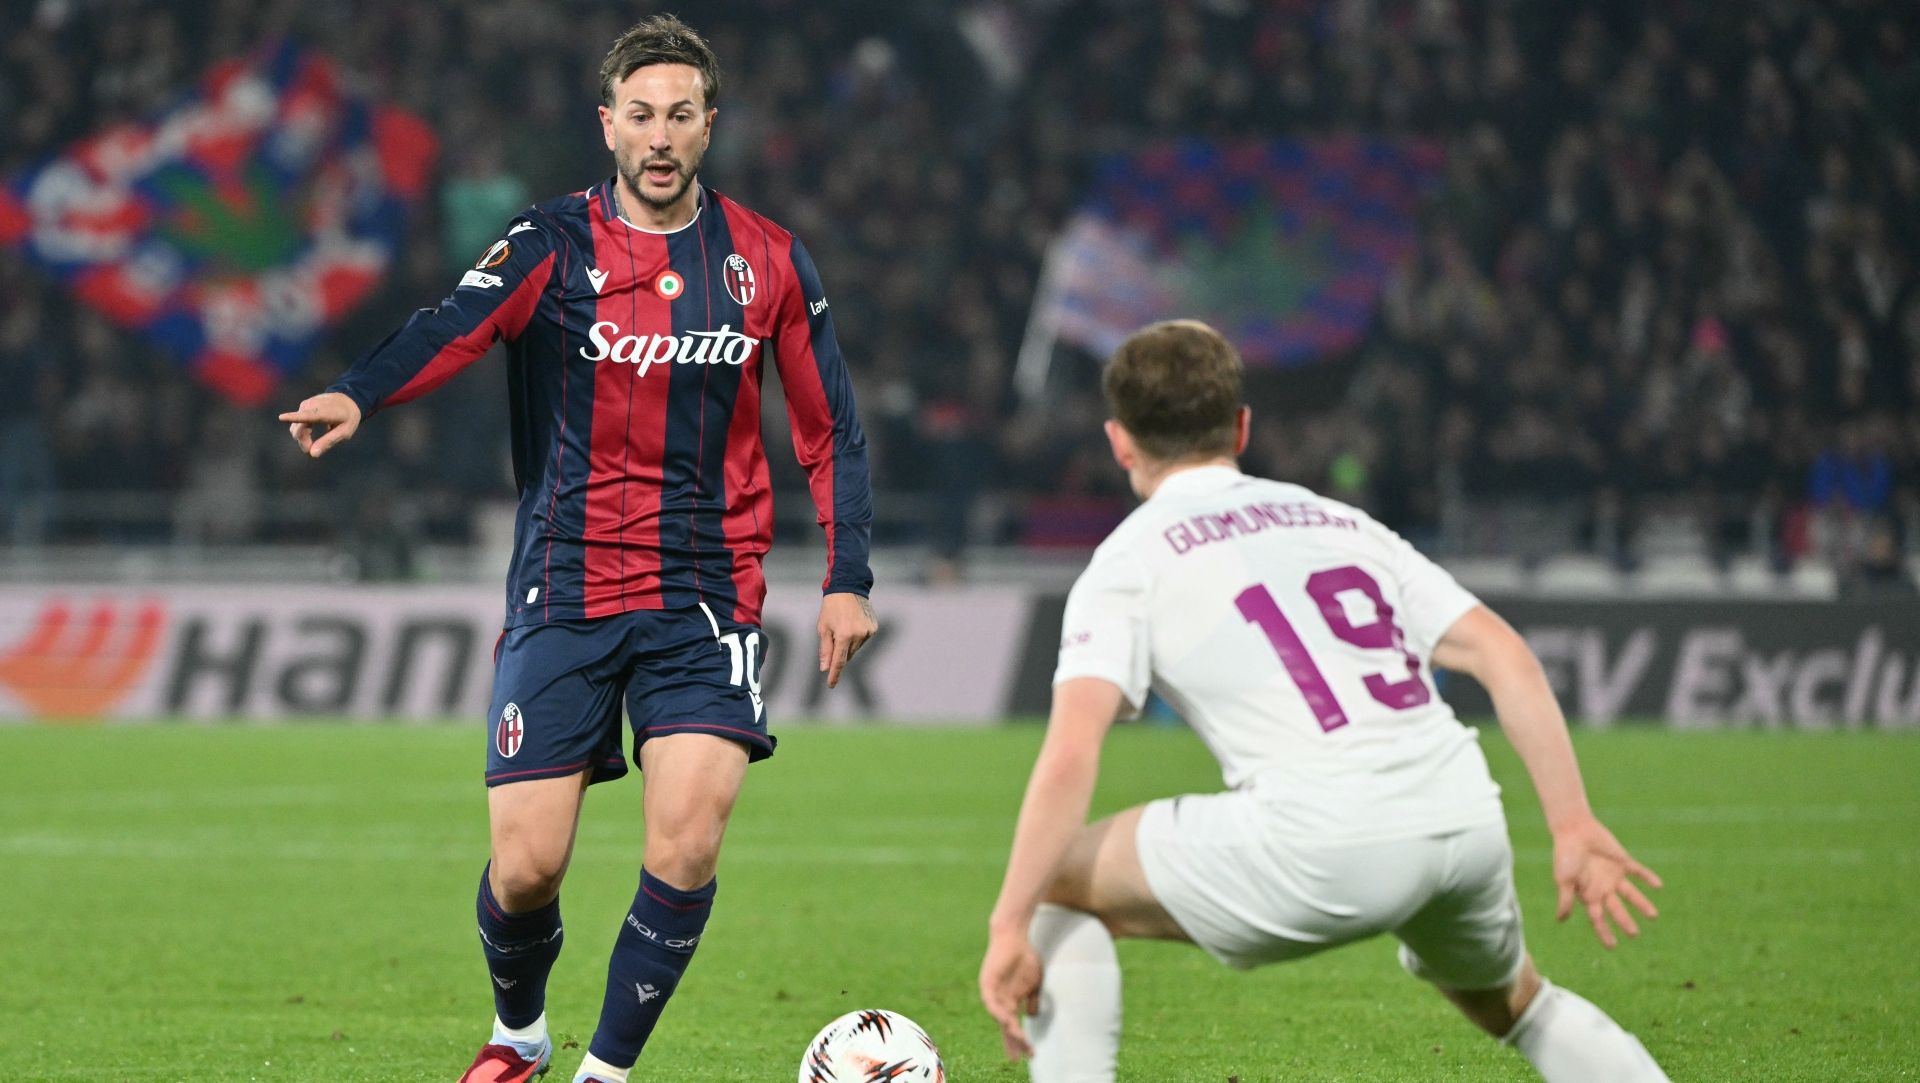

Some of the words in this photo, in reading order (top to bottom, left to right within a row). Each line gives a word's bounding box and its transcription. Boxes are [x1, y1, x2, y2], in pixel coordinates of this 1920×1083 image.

[729, 256, 745, 267] BFC
[579, 321, 759, 378] Saputo
[720, 632, 761, 695] 10
[1234, 565, 1430, 734] 19
